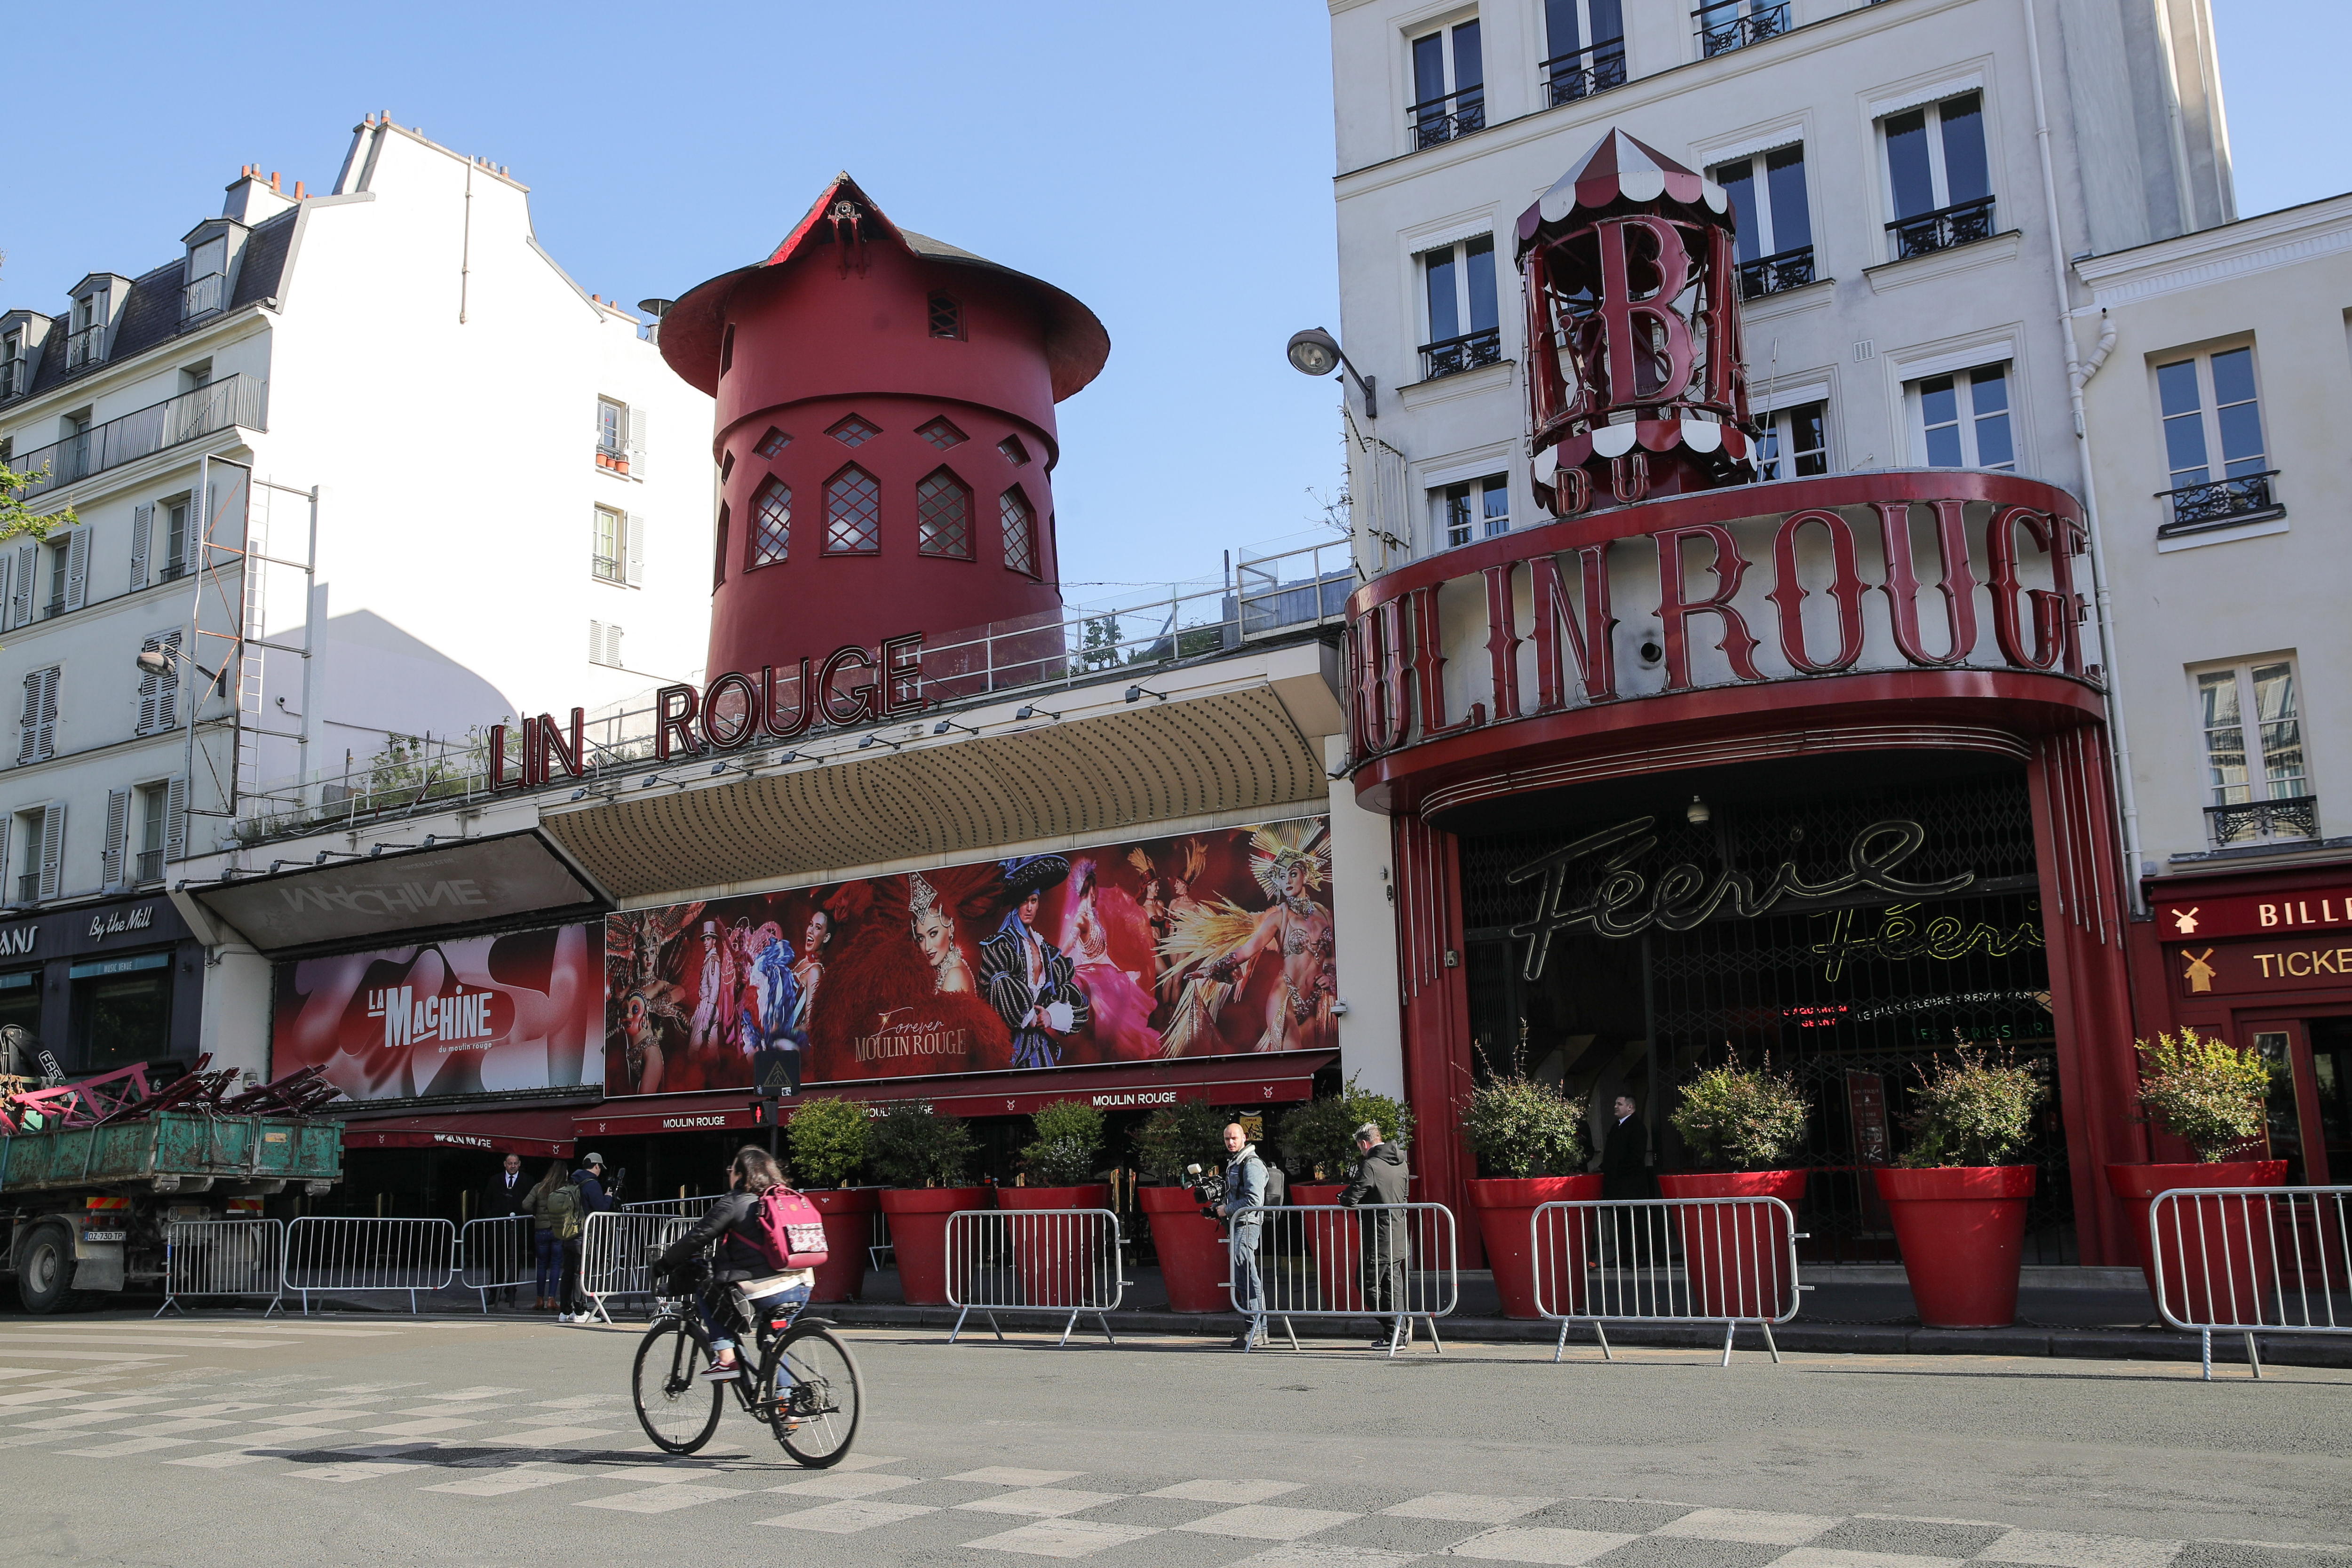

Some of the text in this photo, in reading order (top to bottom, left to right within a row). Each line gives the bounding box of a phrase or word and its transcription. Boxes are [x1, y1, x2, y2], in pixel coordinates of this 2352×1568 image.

[1555, 453, 1650, 517] DU
[1646, 500, 2106, 691] ROUGE
[490, 631, 927, 793] LIN ROUGE
[1507, 816, 1974, 980] Féerie
[89, 906, 152, 942] By the Mill
[104, 961, 132, 973] MUSIC VENUE
[2253, 948, 2352, 978] TICKE
[369, 989, 384, 1010] LA
[871, 1007, 944, 1045] Forever
[1950, 1025, 2011, 1040] ORISS
[449, 1043, 470, 1052] moulin
[855, 1036, 909, 1062] MOULIN
[913, 1029, 966, 1055] ROUGE
[41, 1053, 63, 1082] FAS
[1093, 1092, 1176, 1106] MOULIN ROUGE
[663, 1116, 725, 1128] MOULIN ROUGE
[170, 1208, 179, 1220] 80
